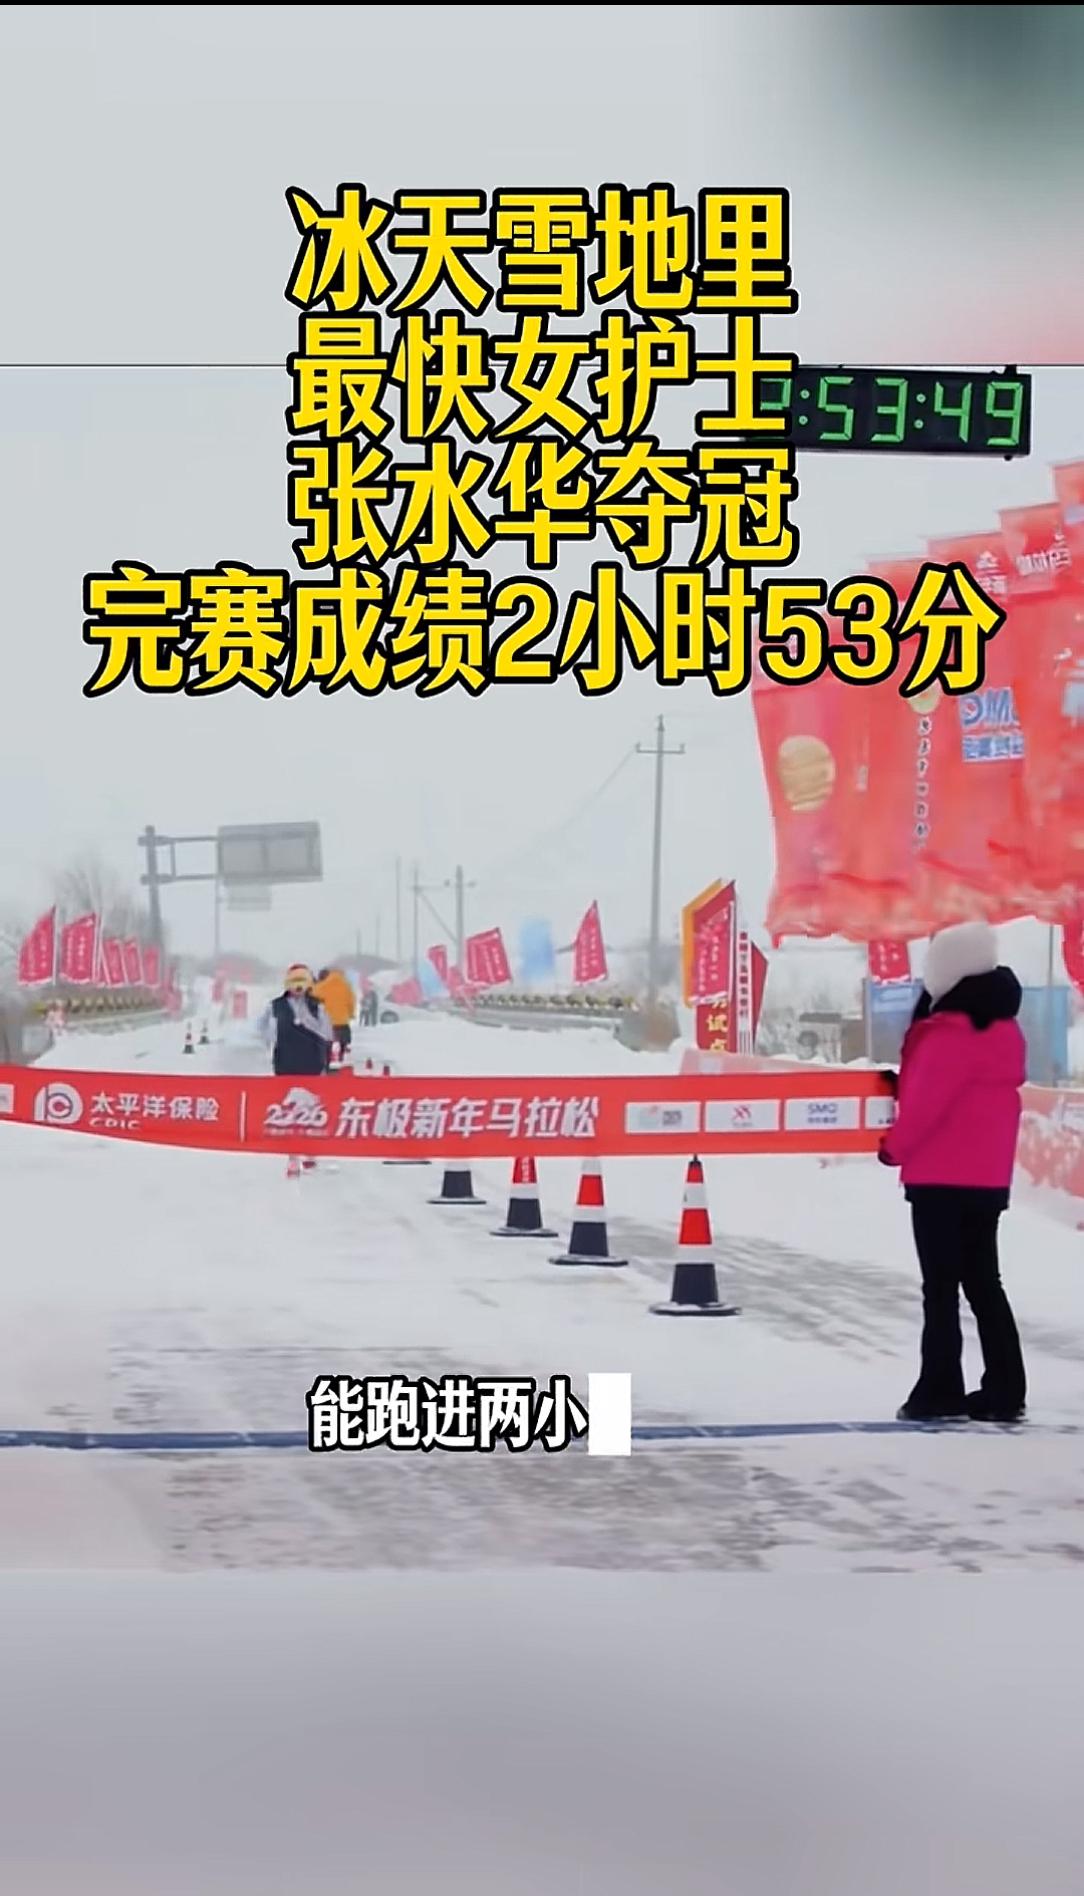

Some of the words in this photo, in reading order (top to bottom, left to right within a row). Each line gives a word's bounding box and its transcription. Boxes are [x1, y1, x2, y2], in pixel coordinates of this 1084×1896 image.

[89, 1090, 220, 1122] 太平洋保险
[334, 1095, 600, 1139] 东极新年马拉松
